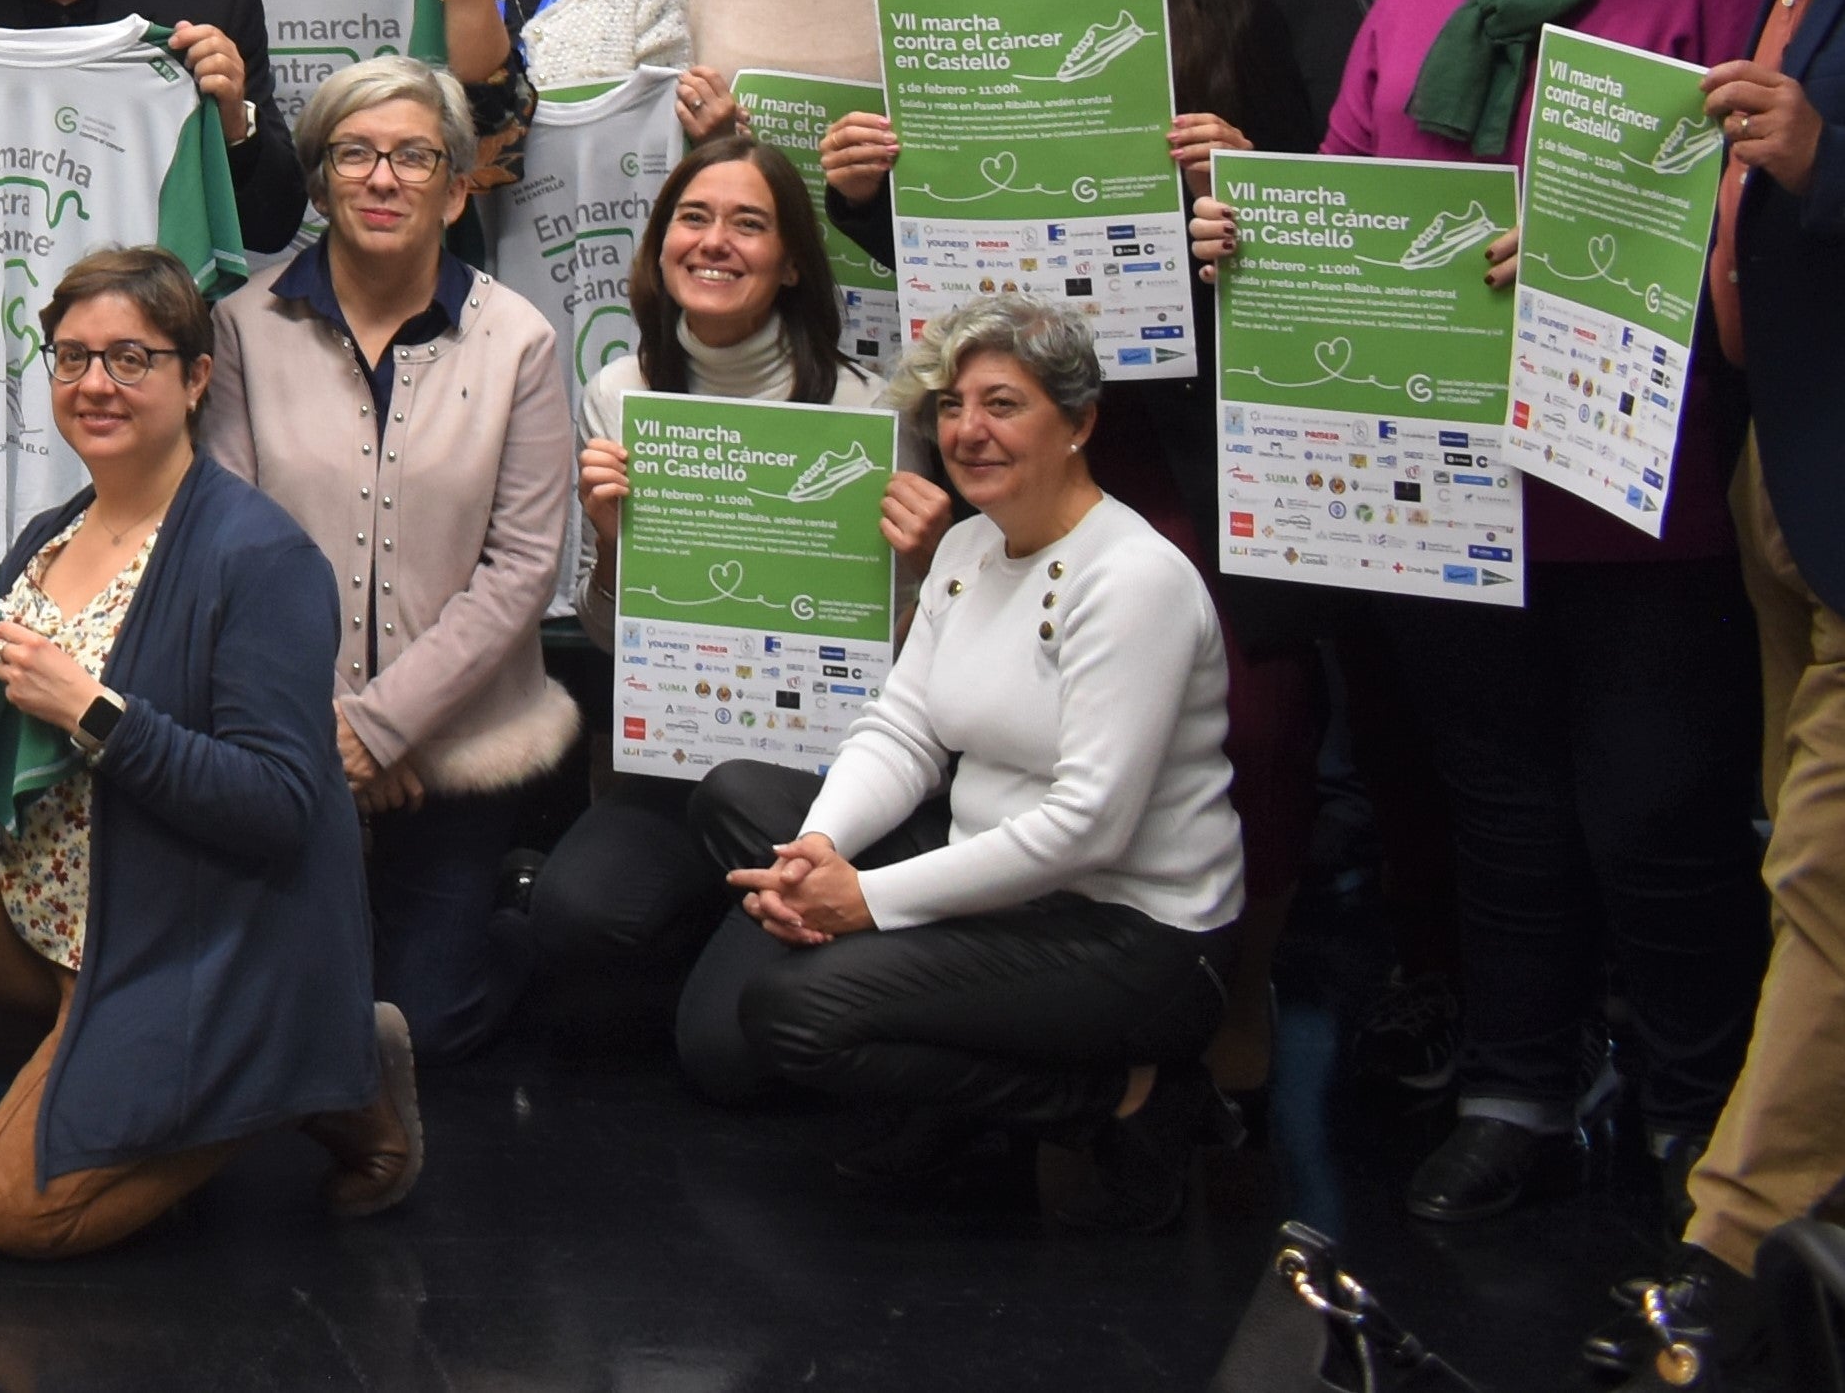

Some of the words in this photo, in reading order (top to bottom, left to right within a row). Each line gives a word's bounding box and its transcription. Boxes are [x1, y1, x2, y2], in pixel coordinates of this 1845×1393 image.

[277, 13, 400, 40] marcha
[892, 14, 916, 30] VII
[922, 14, 1000, 31] marcha
[894, 34, 963, 54] contra
[962, 29, 989, 51] el
[988, 28, 1062, 50] cáncer
[895, 56, 919, 68] en
[924, 48, 1013, 70] Castelló
[1549, 59, 1568, 81] VII
[1570, 69, 1622, 98] marcha
[1545, 85, 1590, 111] contra
[1592, 97, 1607, 116] el
[1609, 103, 1660, 131] cáncer
[1542, 107, 1560, 124] en
[1563, 109, 1621, 143] Castelló
[1228, 182, 1255, 200] VII
[1262, 186, 1346, 208] marcha
[534, 214, 572, 244] En
[1233, 205, 1299, 224] contra
[1305, 203, 1327, 226] el
[1333, 210, 1410, 231] cáncer
[1234, 227, 1259, 242] en
[1261, 225, 1353, 248] Castelló
[635, 420, 660, 437] VII
[666, 425, 741, 445] marcha
[635, 441, 698, 460] contra
[704, 444, 729, 464] el
[728, 442, 797, 466] cáncer
[634, 460, 659, 474] en
[664, 458, 746, 481] Castelló
